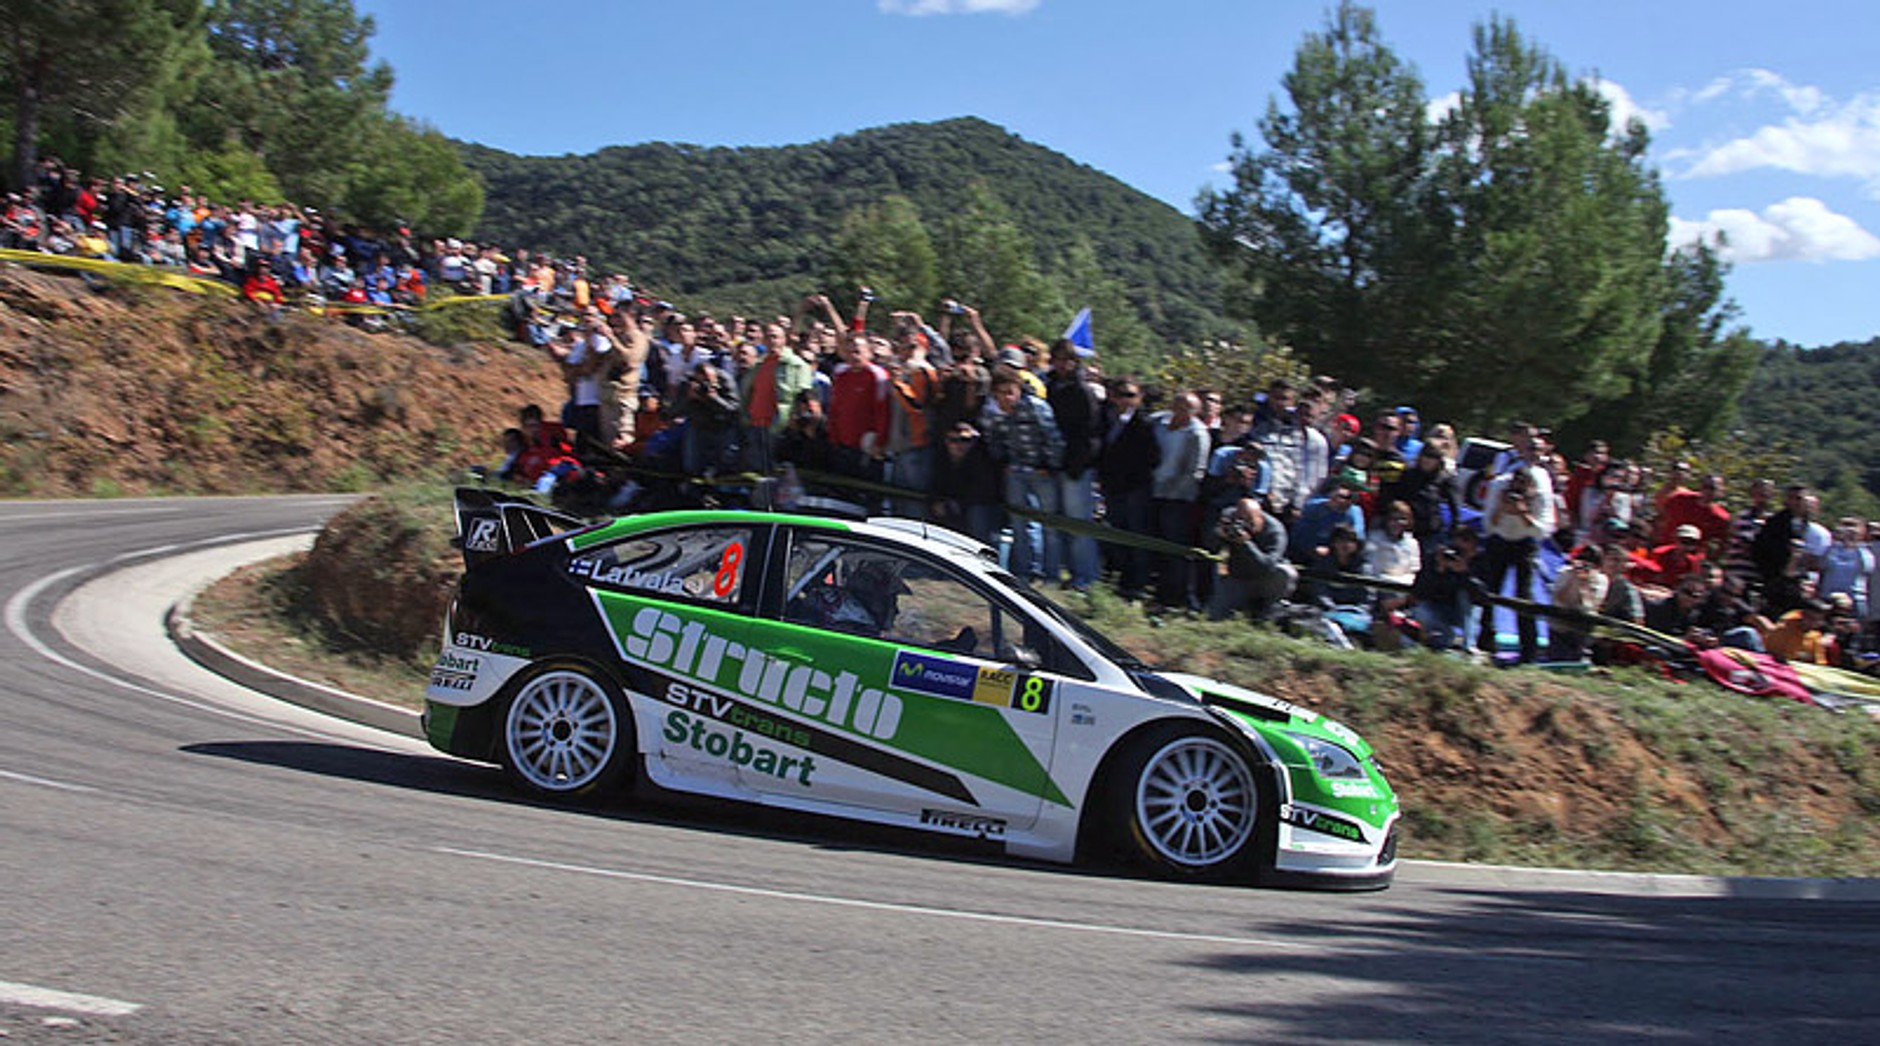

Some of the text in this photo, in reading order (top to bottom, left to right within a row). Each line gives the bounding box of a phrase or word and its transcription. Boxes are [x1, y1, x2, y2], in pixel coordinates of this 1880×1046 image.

[591, 560, 686, 595] Latvala
[713, 542, 743, 597] 8
[626, 607, 903, 740] Structo
[1021, 677, 1043, 711] 8
[663, 710, 816, 786] Stobart
